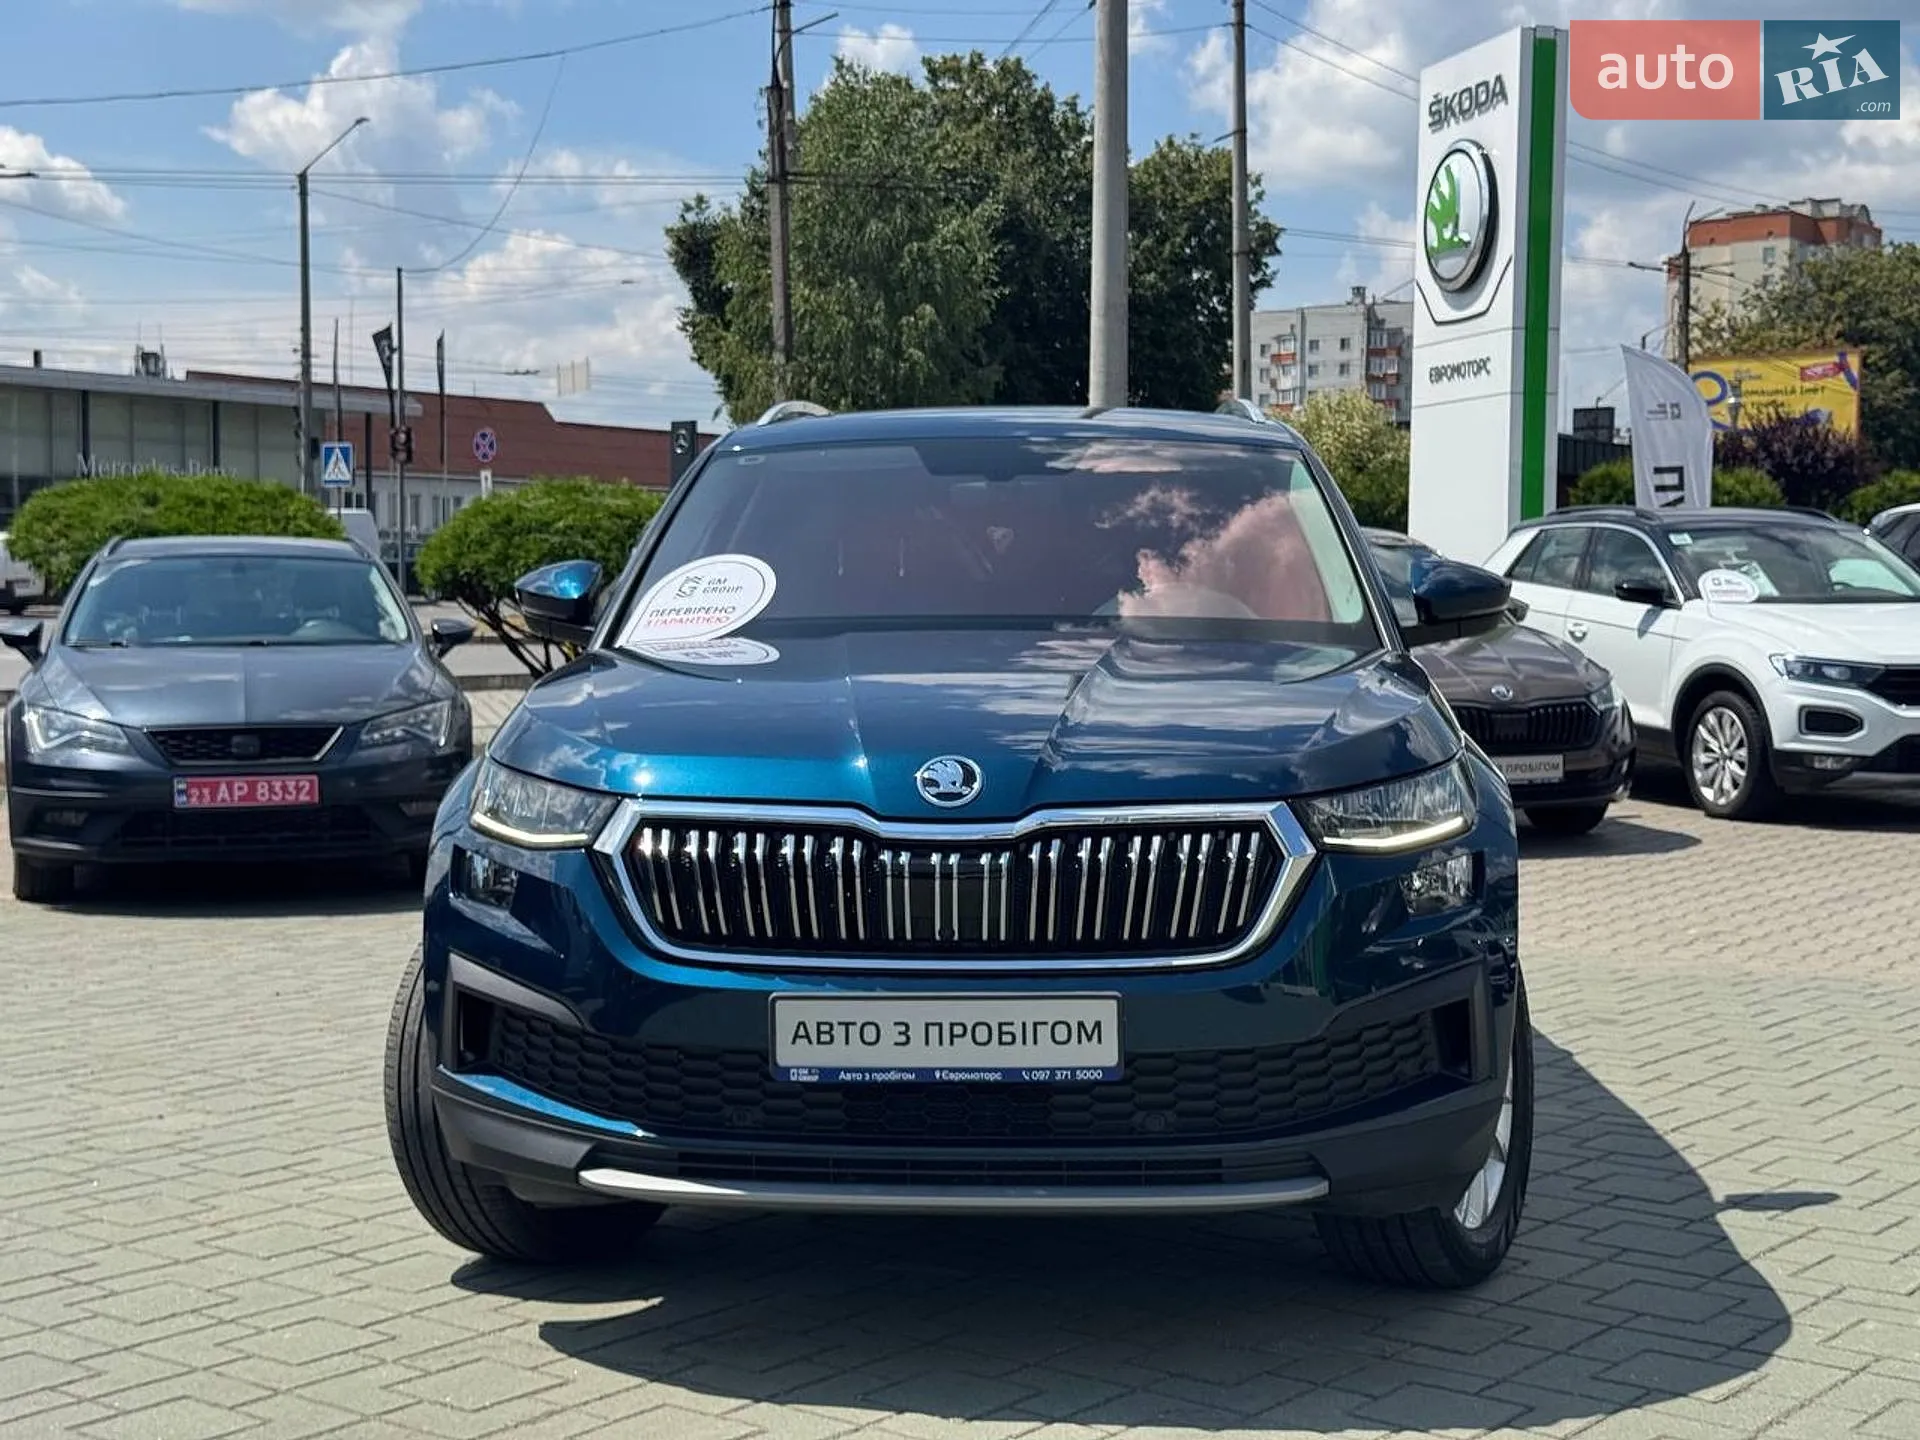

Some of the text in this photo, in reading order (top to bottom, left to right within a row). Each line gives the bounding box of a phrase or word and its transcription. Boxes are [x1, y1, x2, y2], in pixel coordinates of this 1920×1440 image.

[1428, 74, 1508, 128] ŠKODA
[256, 780, 311, 801] 8332
[791, 1020, 1103, 1047] АВТО З ПРОБІГОМ
[838, 1070, 862, 1080] Авто
[871, 1070, 916, 1082] пробігом
[1031, 1069, 1103, 1080] 097 371 5000
